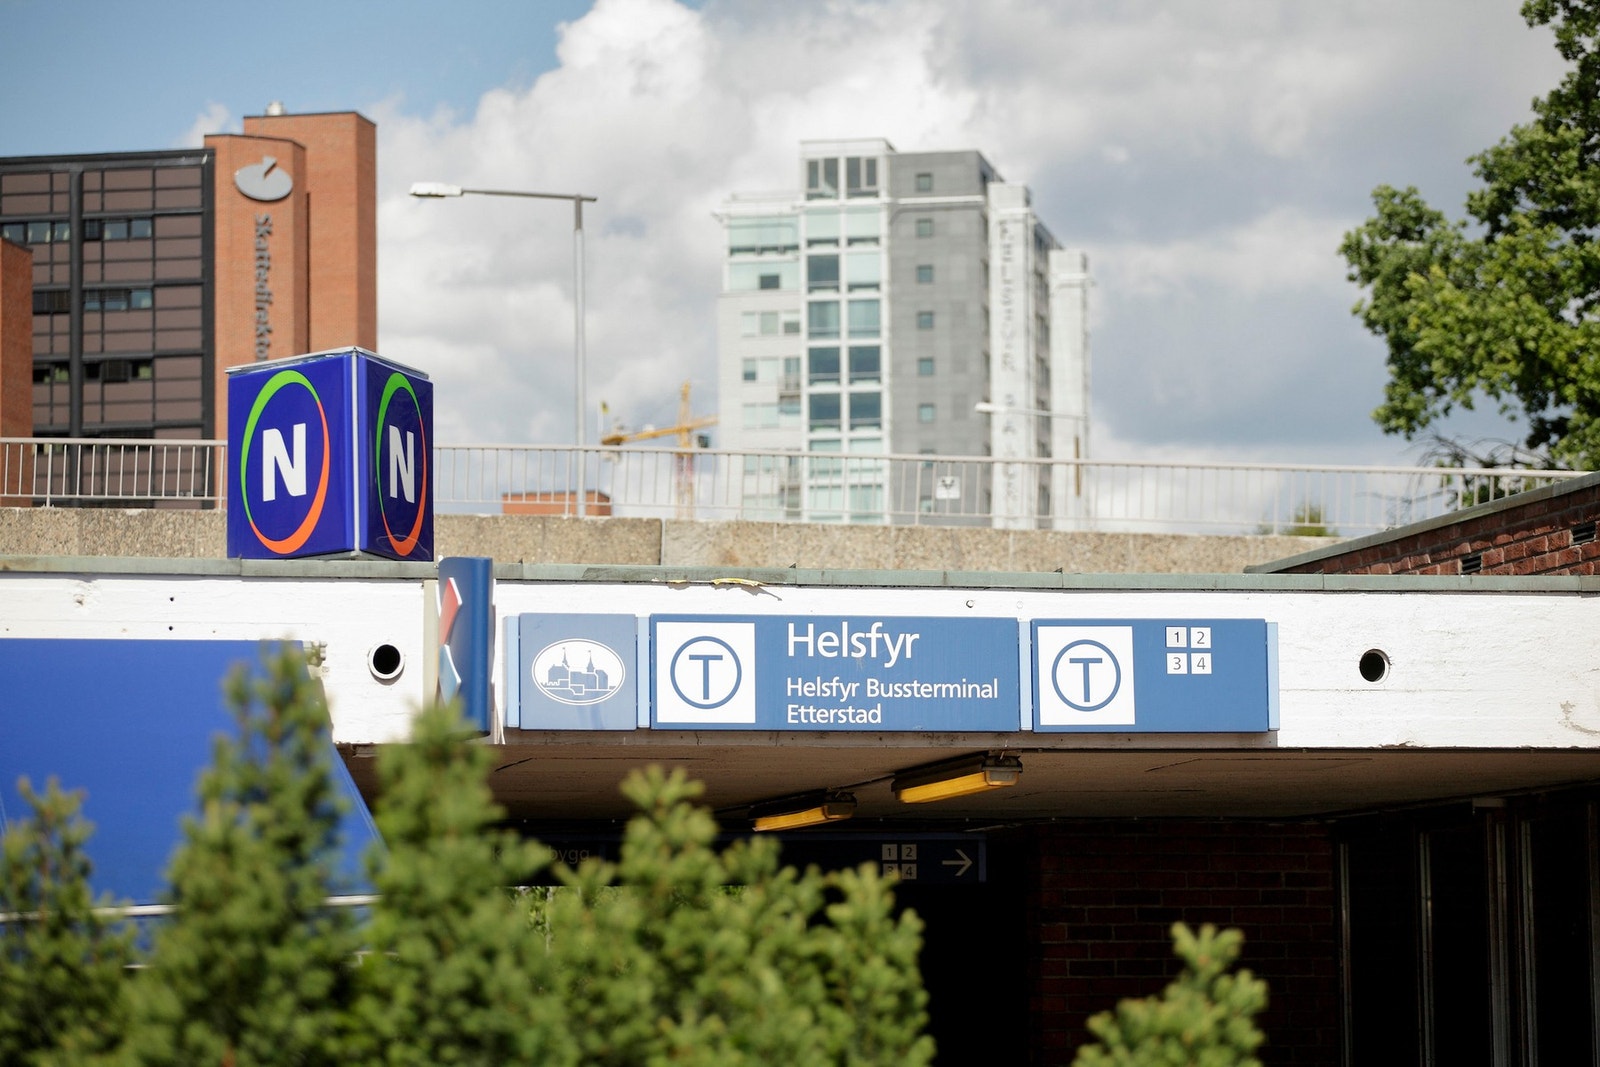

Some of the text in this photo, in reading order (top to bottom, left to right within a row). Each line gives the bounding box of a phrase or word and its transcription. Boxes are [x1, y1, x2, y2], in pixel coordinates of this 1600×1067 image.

[256, 213, 272, 362] Skattedirekto
[263, 423, 307, 502] N
[389, 424, 415, 504] N
[787, 621, 920, 668] Helsfyr
[1173, 631, 1206, 645] 1 2
[689, 654, 723, 700] T
[1069, 658, 1103, 703] T
[1173, 657, 1206, 670] 3 4
[787, 677, 998, 702] Helsfyr Bussterminal
[787, 703, 882, 725] Etterstad
